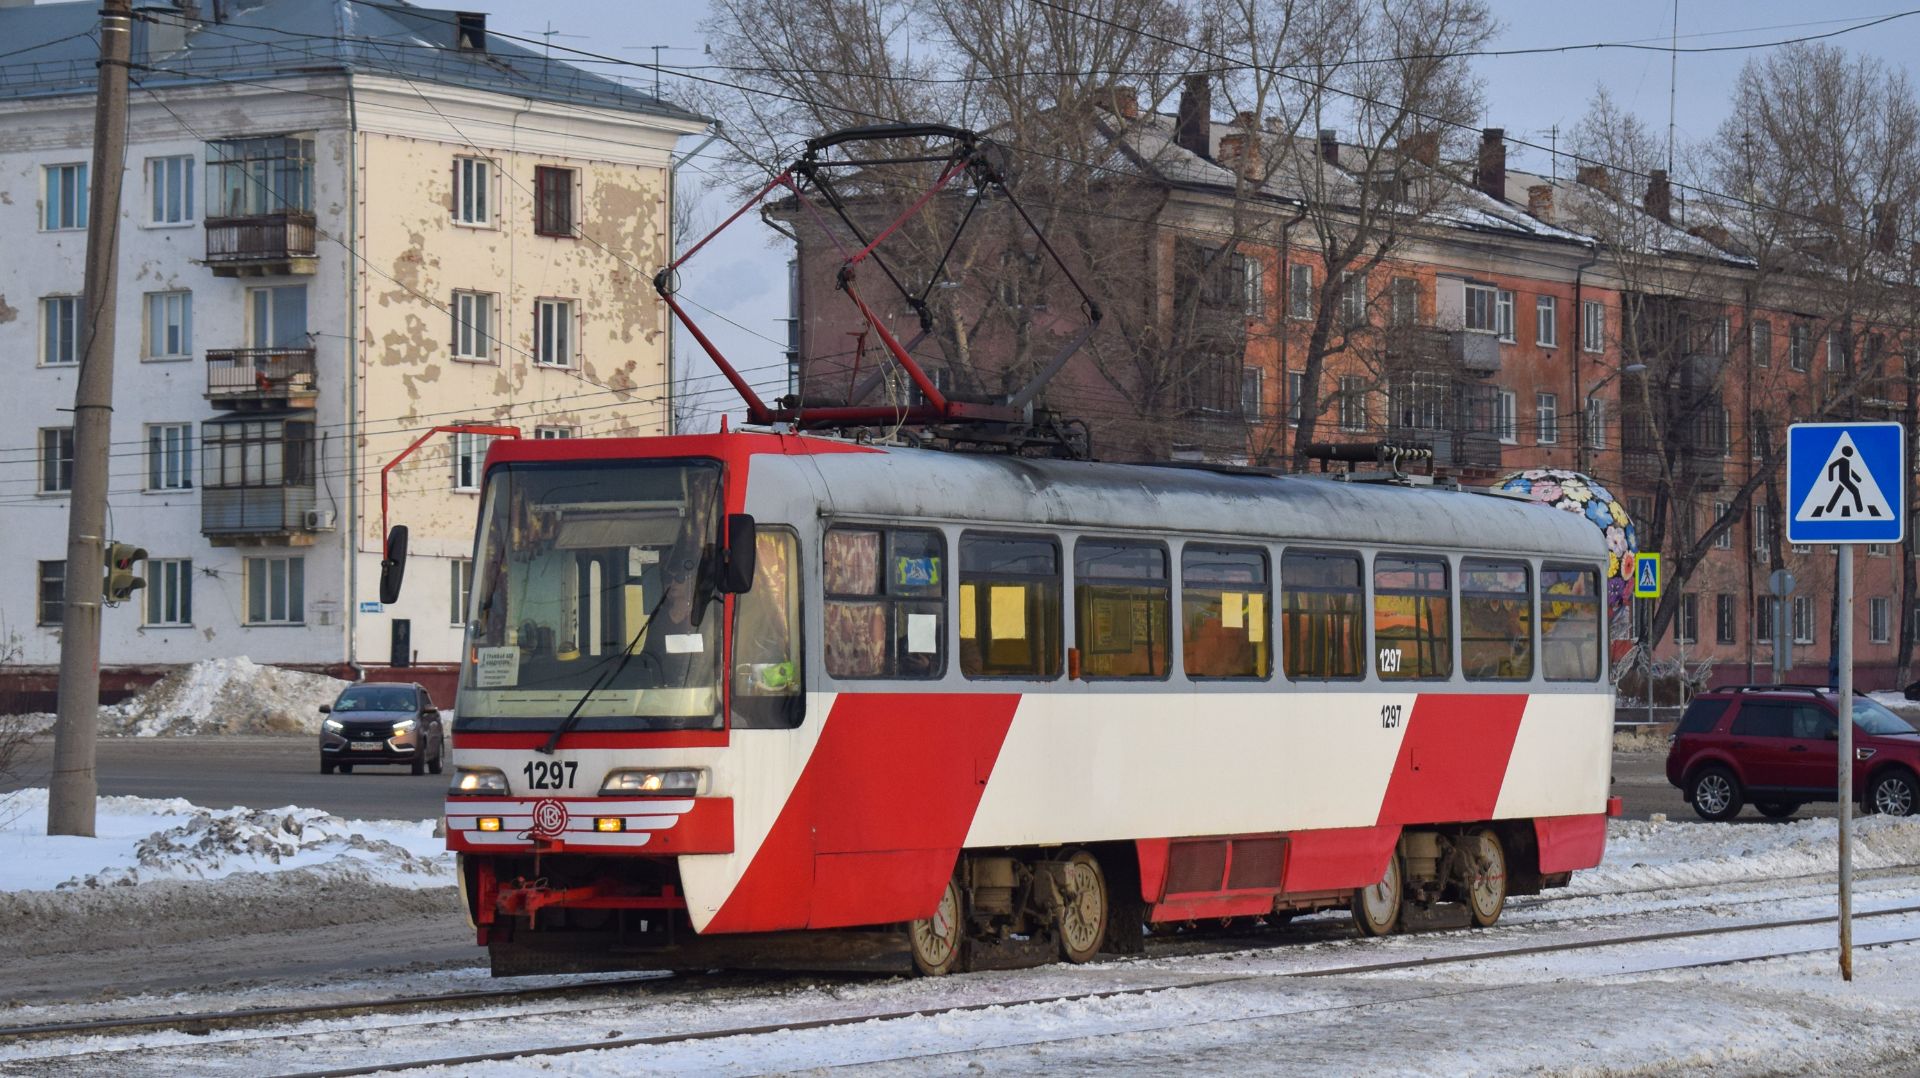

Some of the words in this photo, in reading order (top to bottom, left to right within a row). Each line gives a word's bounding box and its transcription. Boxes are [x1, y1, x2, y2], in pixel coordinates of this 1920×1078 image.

[1380, 649, 1401, 672] 1297
[1381, 705, 1401, 728] 1297
[524, 761, 578, 789] 1297
